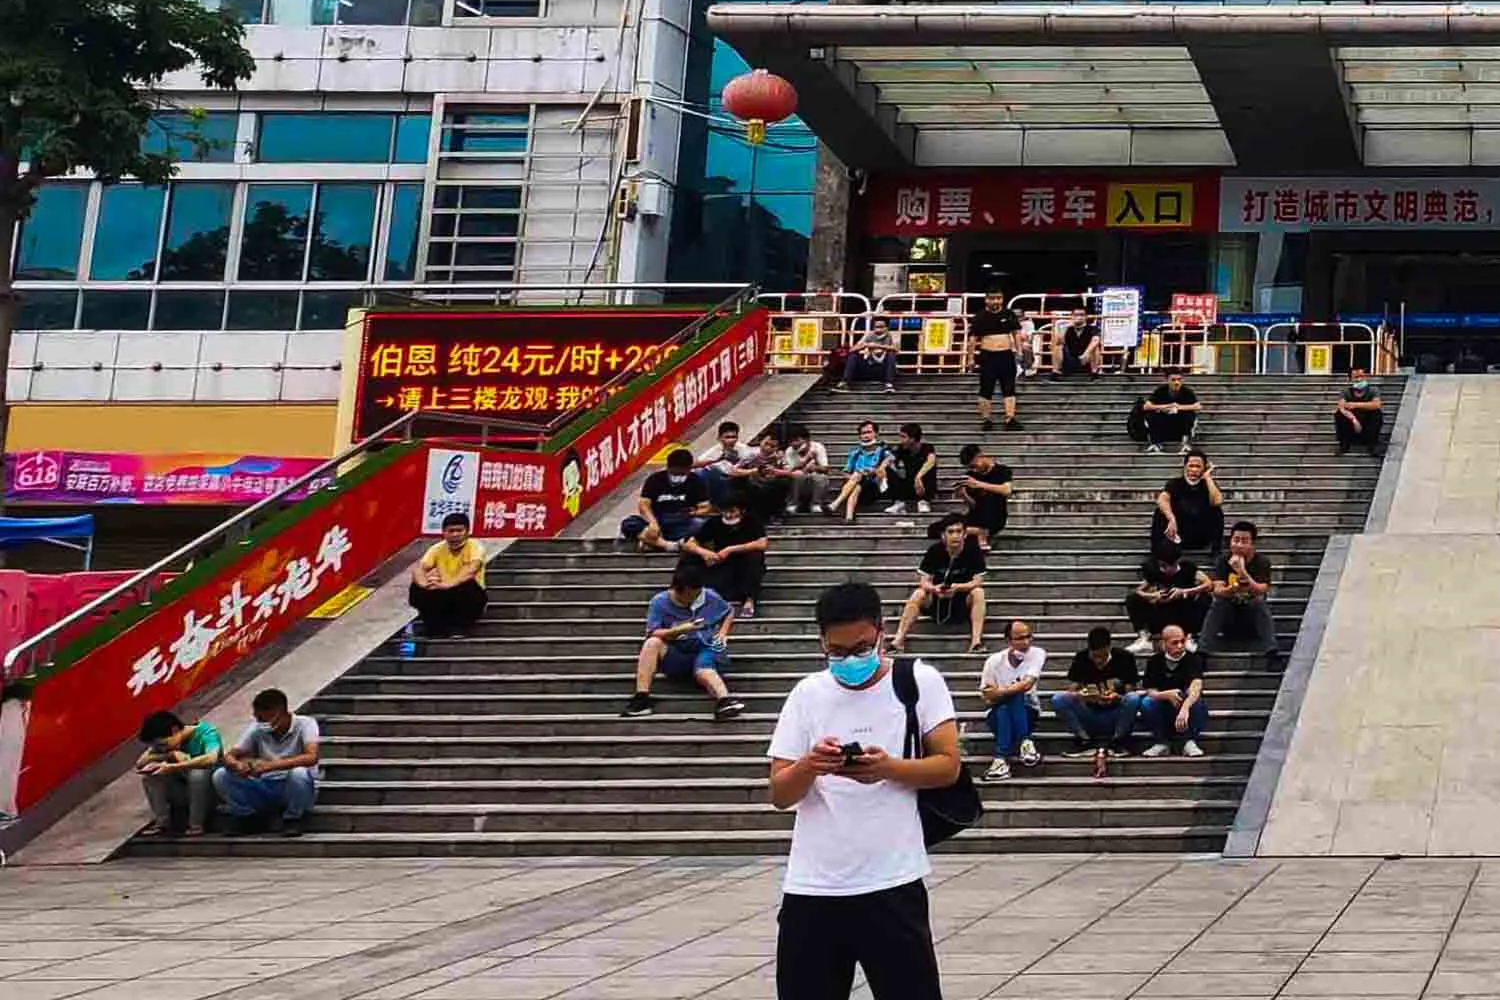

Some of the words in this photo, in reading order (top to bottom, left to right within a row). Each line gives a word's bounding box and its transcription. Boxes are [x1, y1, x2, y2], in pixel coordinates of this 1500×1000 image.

[896, 186, 1097, 227] 购票、乘车
[1114, 188, 1184, 225] 入口
[371, 345, 437, 376] 伯恩
[16, 466, 58, 487] 618
